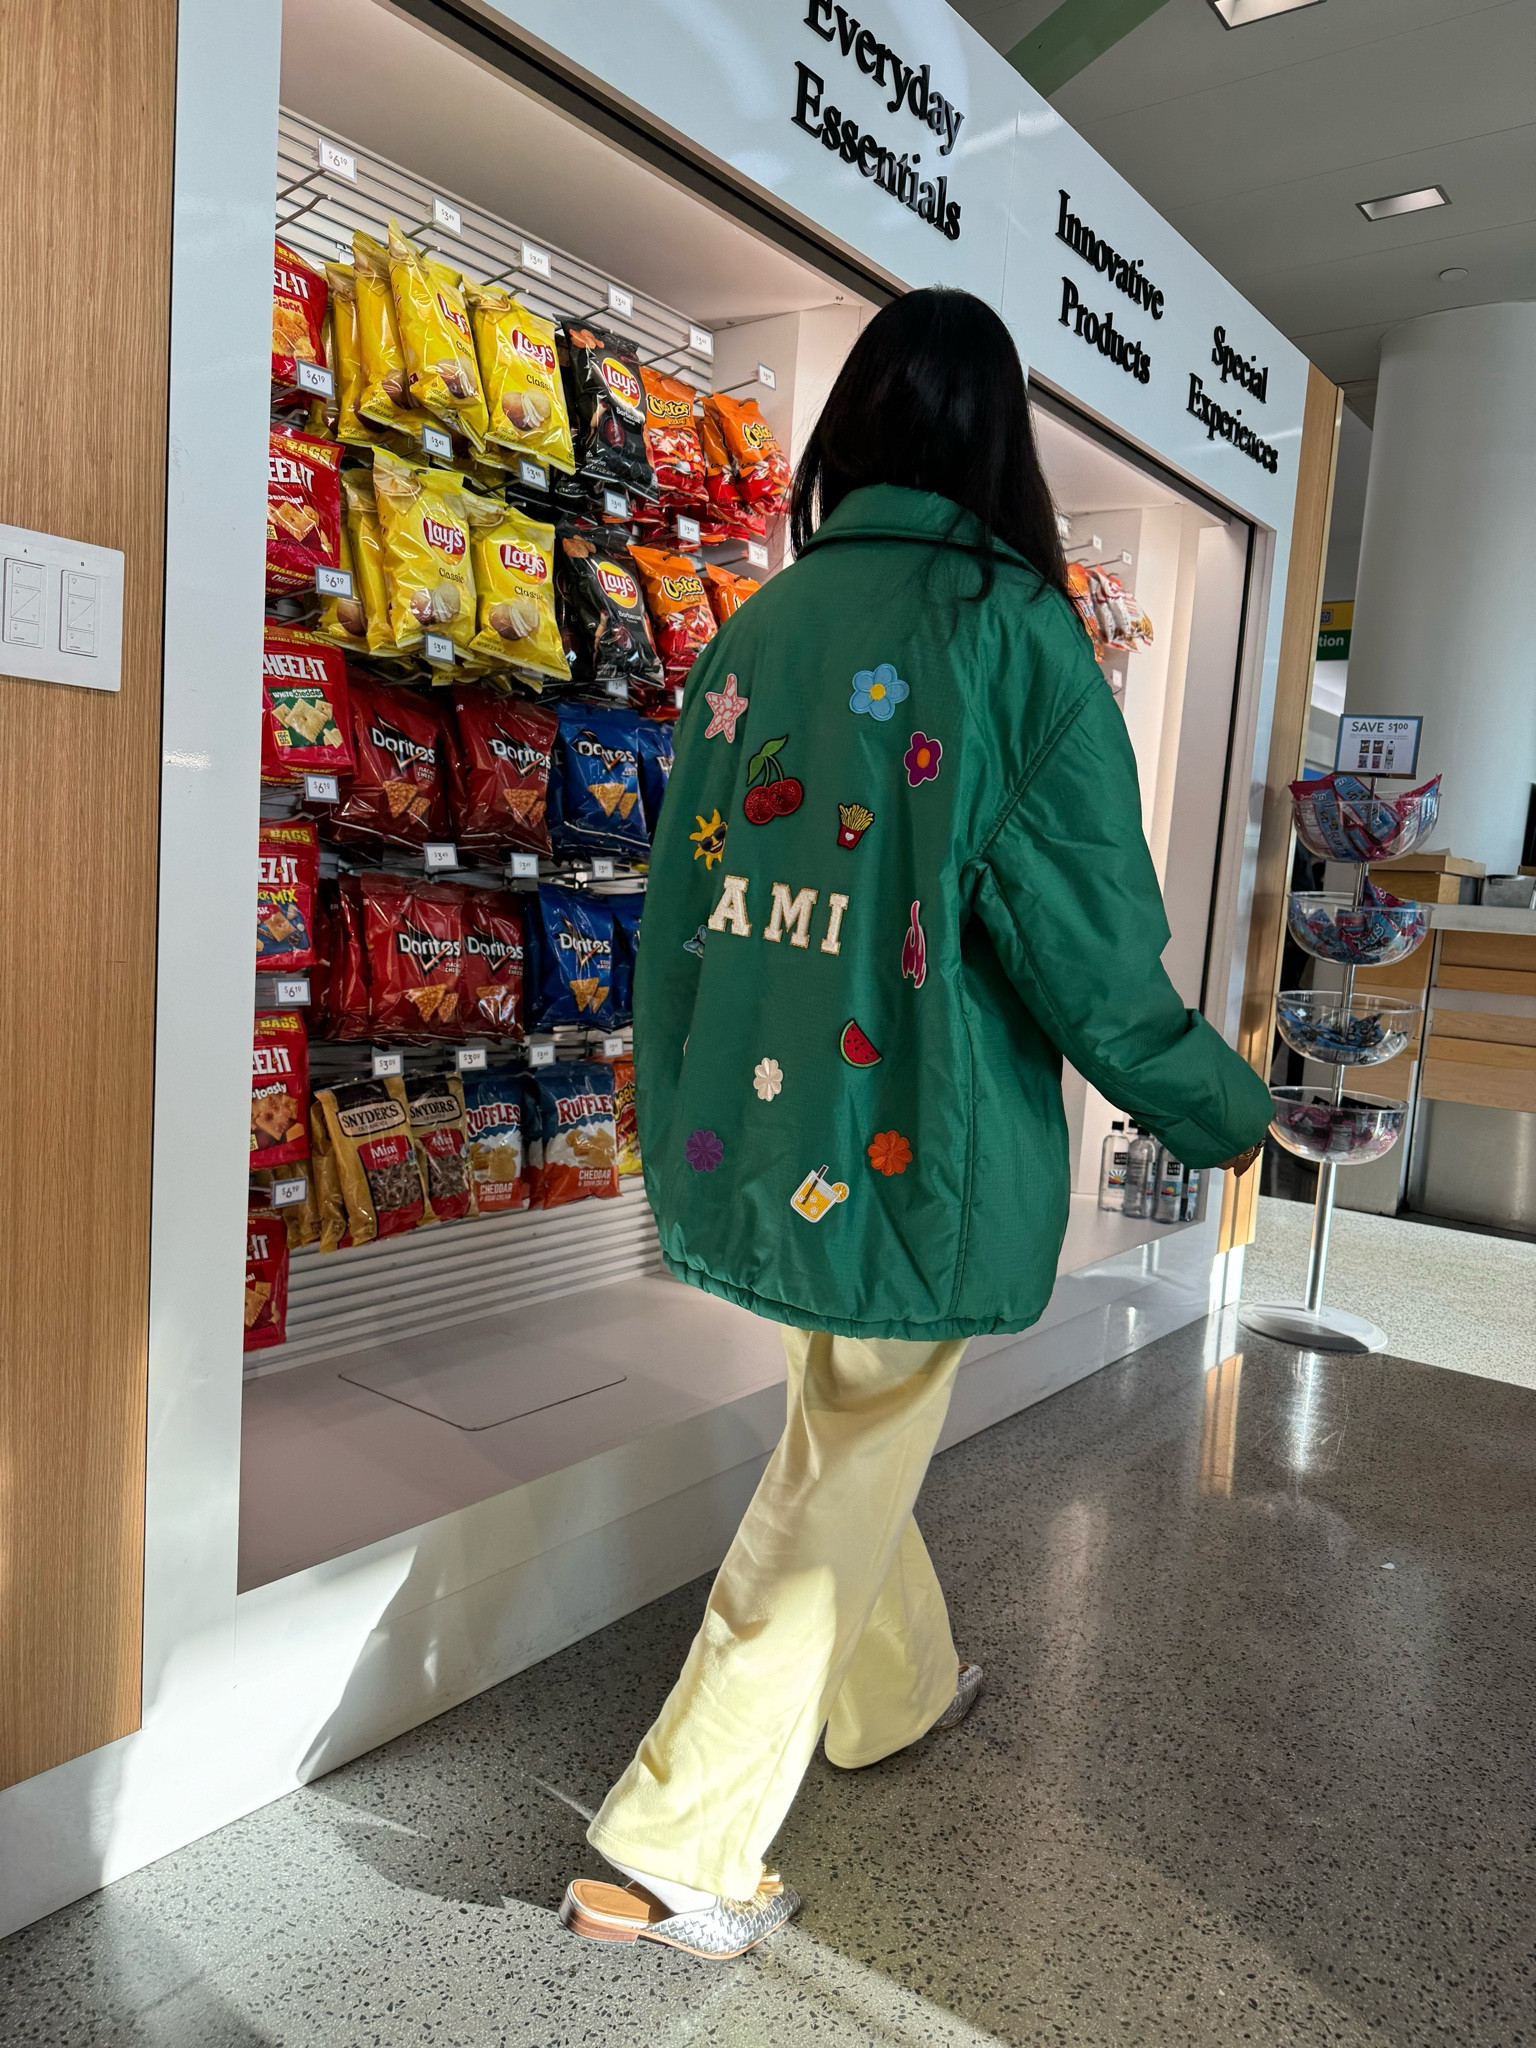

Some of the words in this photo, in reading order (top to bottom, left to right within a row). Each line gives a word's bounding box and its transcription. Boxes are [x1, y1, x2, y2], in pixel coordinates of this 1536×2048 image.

[803, 0, 965, 156] Everyday
[791, 60, 961, 241] Essentials
[1055, 189, 1165, 321] Innovative
[1058, 276, 1152, 385] Products
[1211, 325, 1269, 404] Special
[1186, 372, 1278, 474] Experiences
[286, 440, 333, 466] BAGS
[1351, 721, 1385, 733] SAVE
[371, 726, 436, 764] Doritos
[489, 738, 551, 769] Doritos
[269, 829, 311, 843] BAGS
[707, 874, 849, 956] AMI
[398, 933, 460, 956] Doritos
[467, 935, 523, 959] Doritos
[260, 1016, 299, 1029] BAGS
[341, 1104, 400, 1129] SNYDER'S
[465, 1102, 521, 1137] RUFFLES
[556, 1094, 614, 1126] RUFFLES
[370, 1141, 398, 1159] Mini
[480, 1182, 513, 1195] CHEDDAR
[579, 1170, 611, 1180] CHEDDAR
